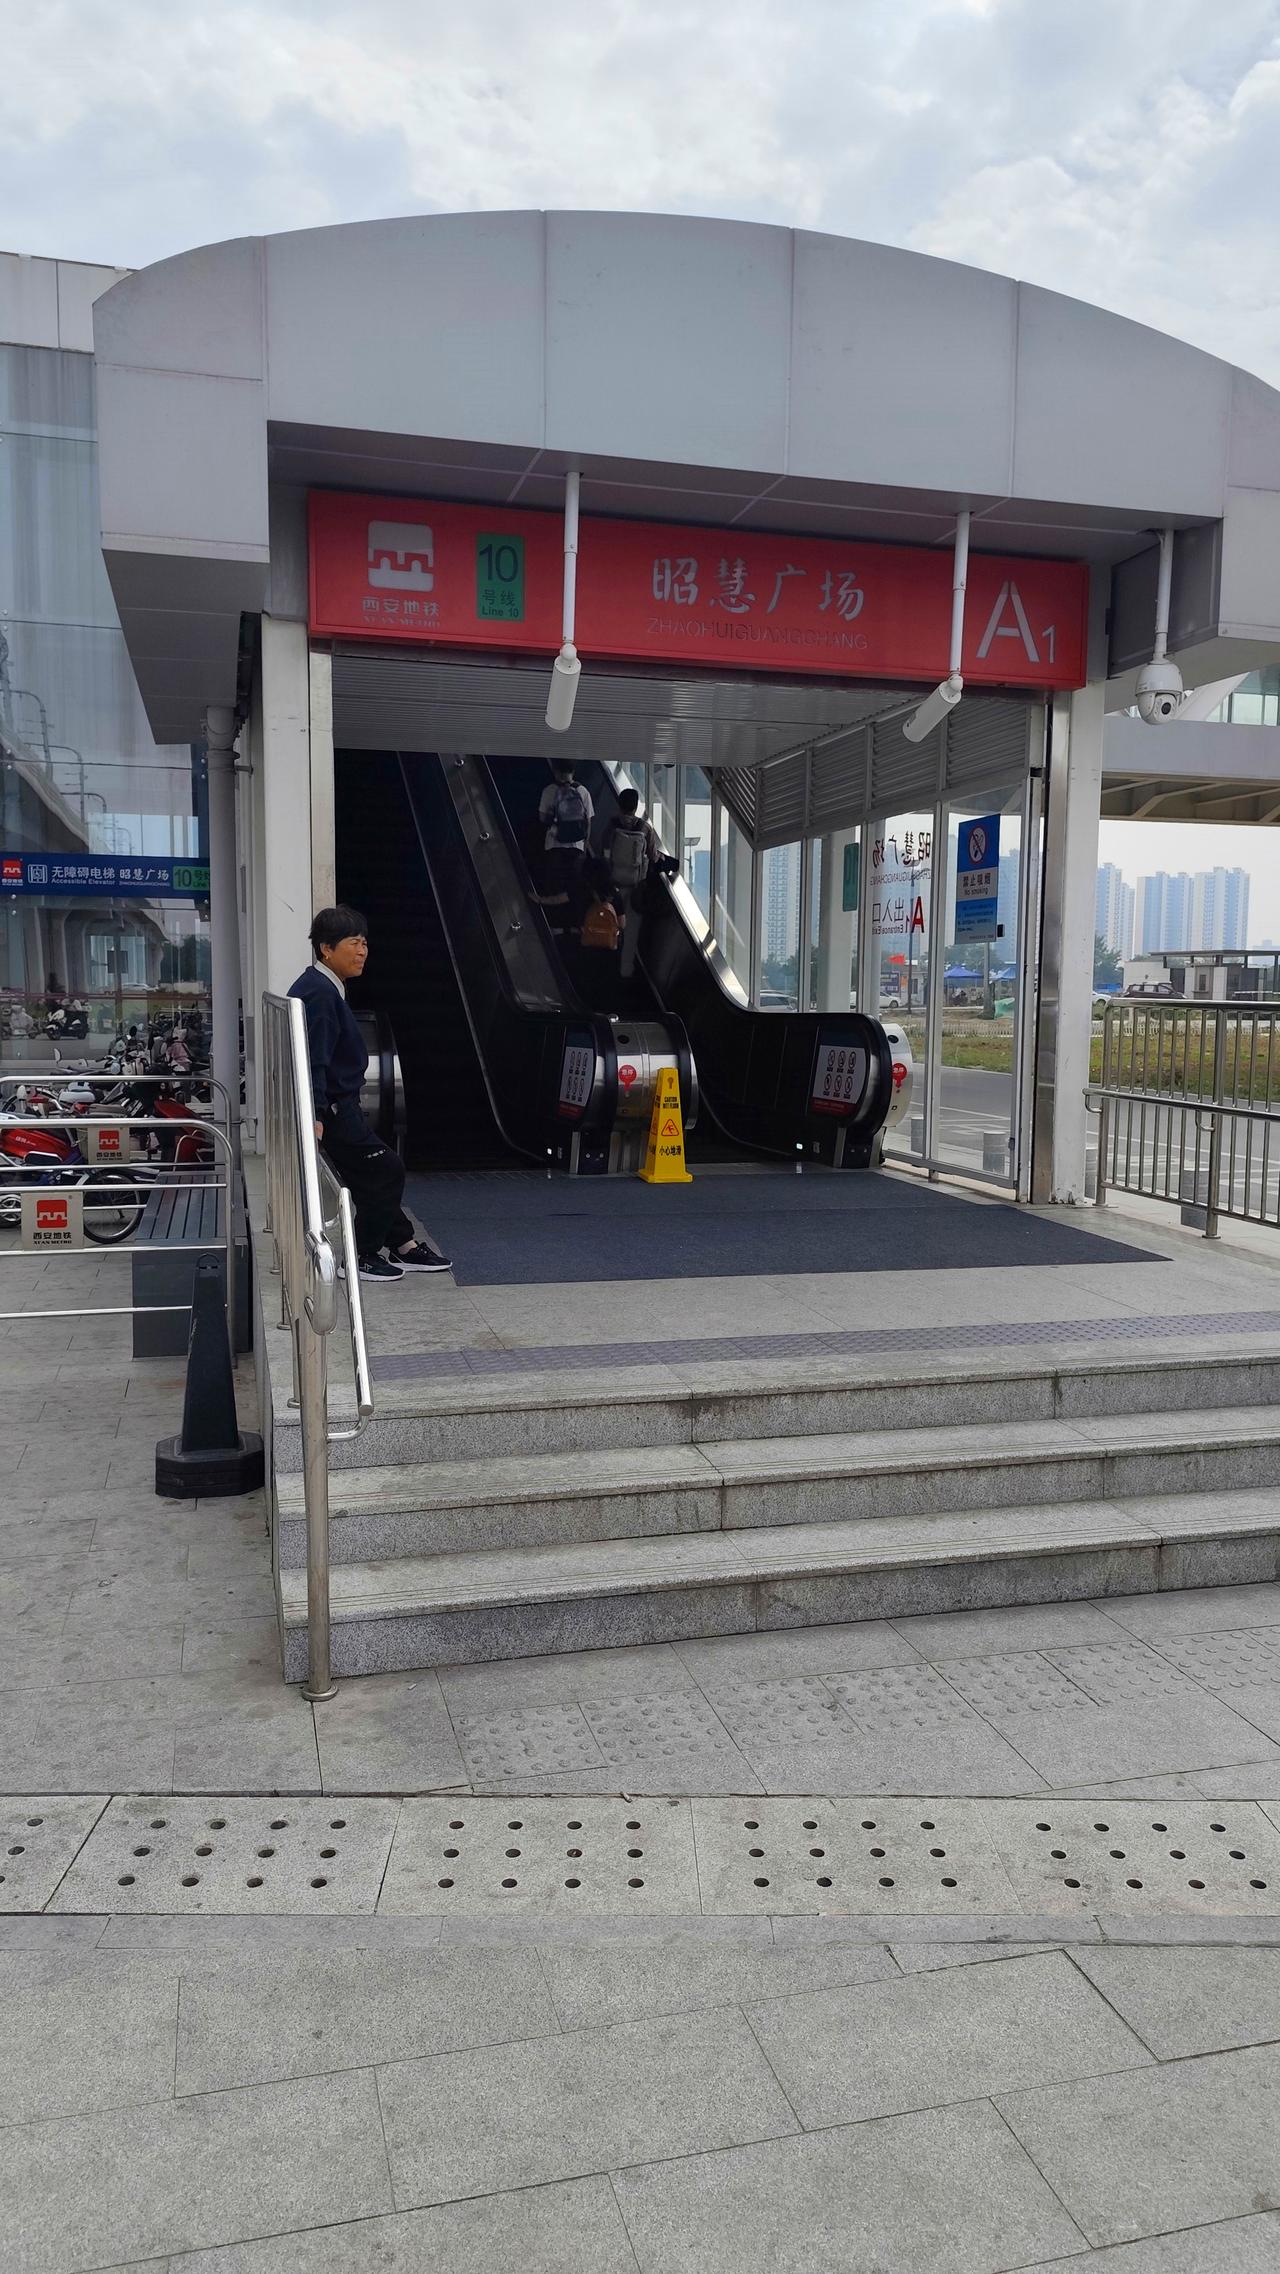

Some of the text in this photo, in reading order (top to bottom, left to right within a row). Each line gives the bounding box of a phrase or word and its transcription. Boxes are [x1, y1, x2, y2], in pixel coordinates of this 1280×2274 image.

[479, 544, 518, 582] 10
[482, 588, 516, 607] 号线
[652, 556, 864, 622] 昭慧广场
[363, 597, 440, 617] 西安地铁
[481, 606, 519, 618] Line 10
[647, 617, 868, 650] ZHAOHUIGUANGCHANG
[51, 866, 169, 881] 无障碍电梯 昭慧广场
[174, 869, 192, 888] 10
[659, 1145, 682, 1155] 小心地滑
[33, 1232, 72, 1240] 西安地铁
